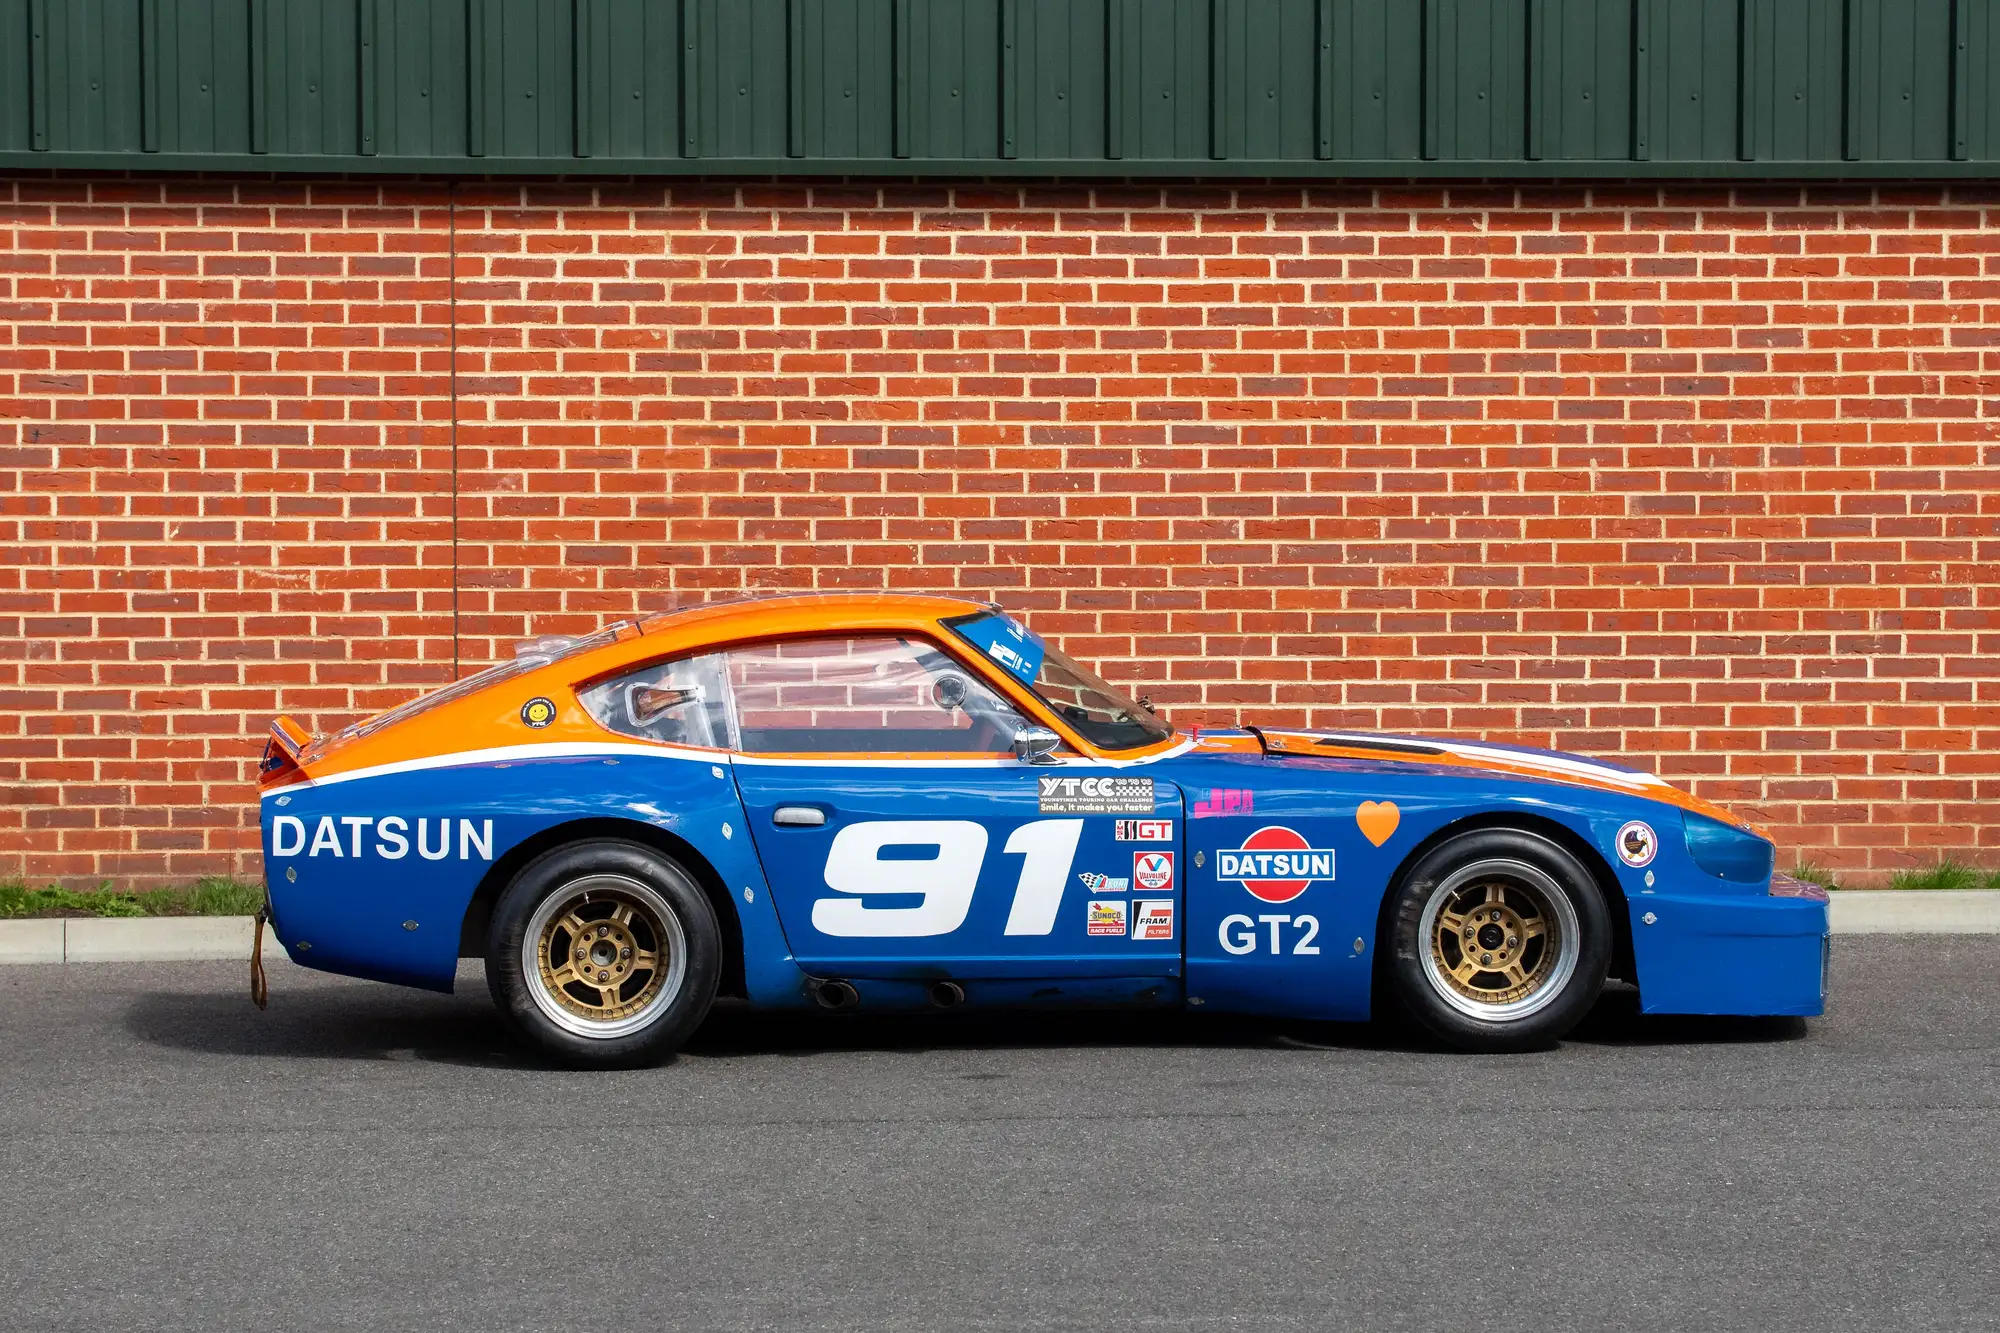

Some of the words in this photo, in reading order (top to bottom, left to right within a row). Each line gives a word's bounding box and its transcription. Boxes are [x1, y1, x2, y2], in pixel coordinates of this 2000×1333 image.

[1039, 777, 1116, 797] YTCC
[1040, 803, 1067, 812] Smile,
[1068, 803, 1075, 811] it
[1076, 803, 1105, 811] makes
[1106, 805, 1123, 813] you
[1124, 803, 1153, 811] faster
[272, 815, 493, 861] DATSUN
[1138, 822, 1171, 839] GT
[1221, 854, 1330, 876] DATSUN
[811, 819, 1084, 938] 91
[1139, 871, 1168, 880] VALVOLINE
[1092, 911, 1121, 919] SUNOCO
[1139, 917, 1167, 925] FRAM
[1218, 913, 1321, 956] GT2
